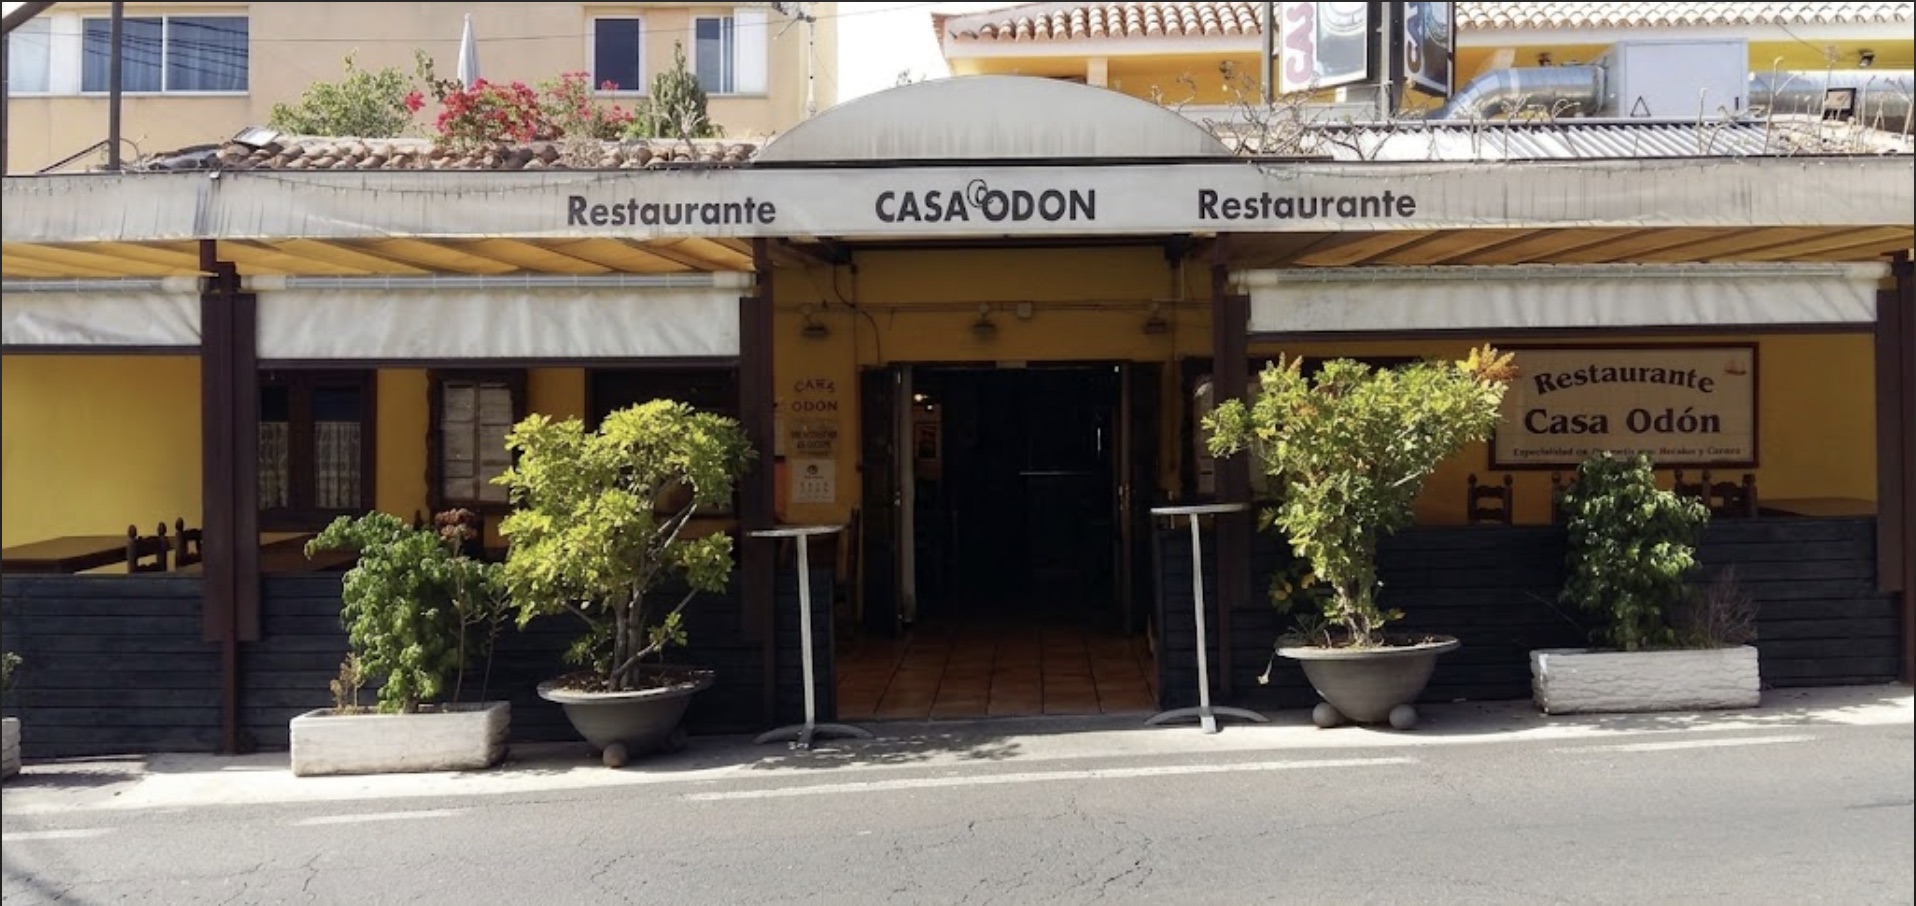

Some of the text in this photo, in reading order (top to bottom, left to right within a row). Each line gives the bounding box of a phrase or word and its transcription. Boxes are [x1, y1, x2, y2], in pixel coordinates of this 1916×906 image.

[567, 195, 777, 226] Restaurante
[875, 189, 1096, 222] CASA ODON
[1198, 189, 1416, 219] Restaurante
[1534, 363, 1715, 396] Restaurante
[1524, 406, 1721, 434] Casa Odón
